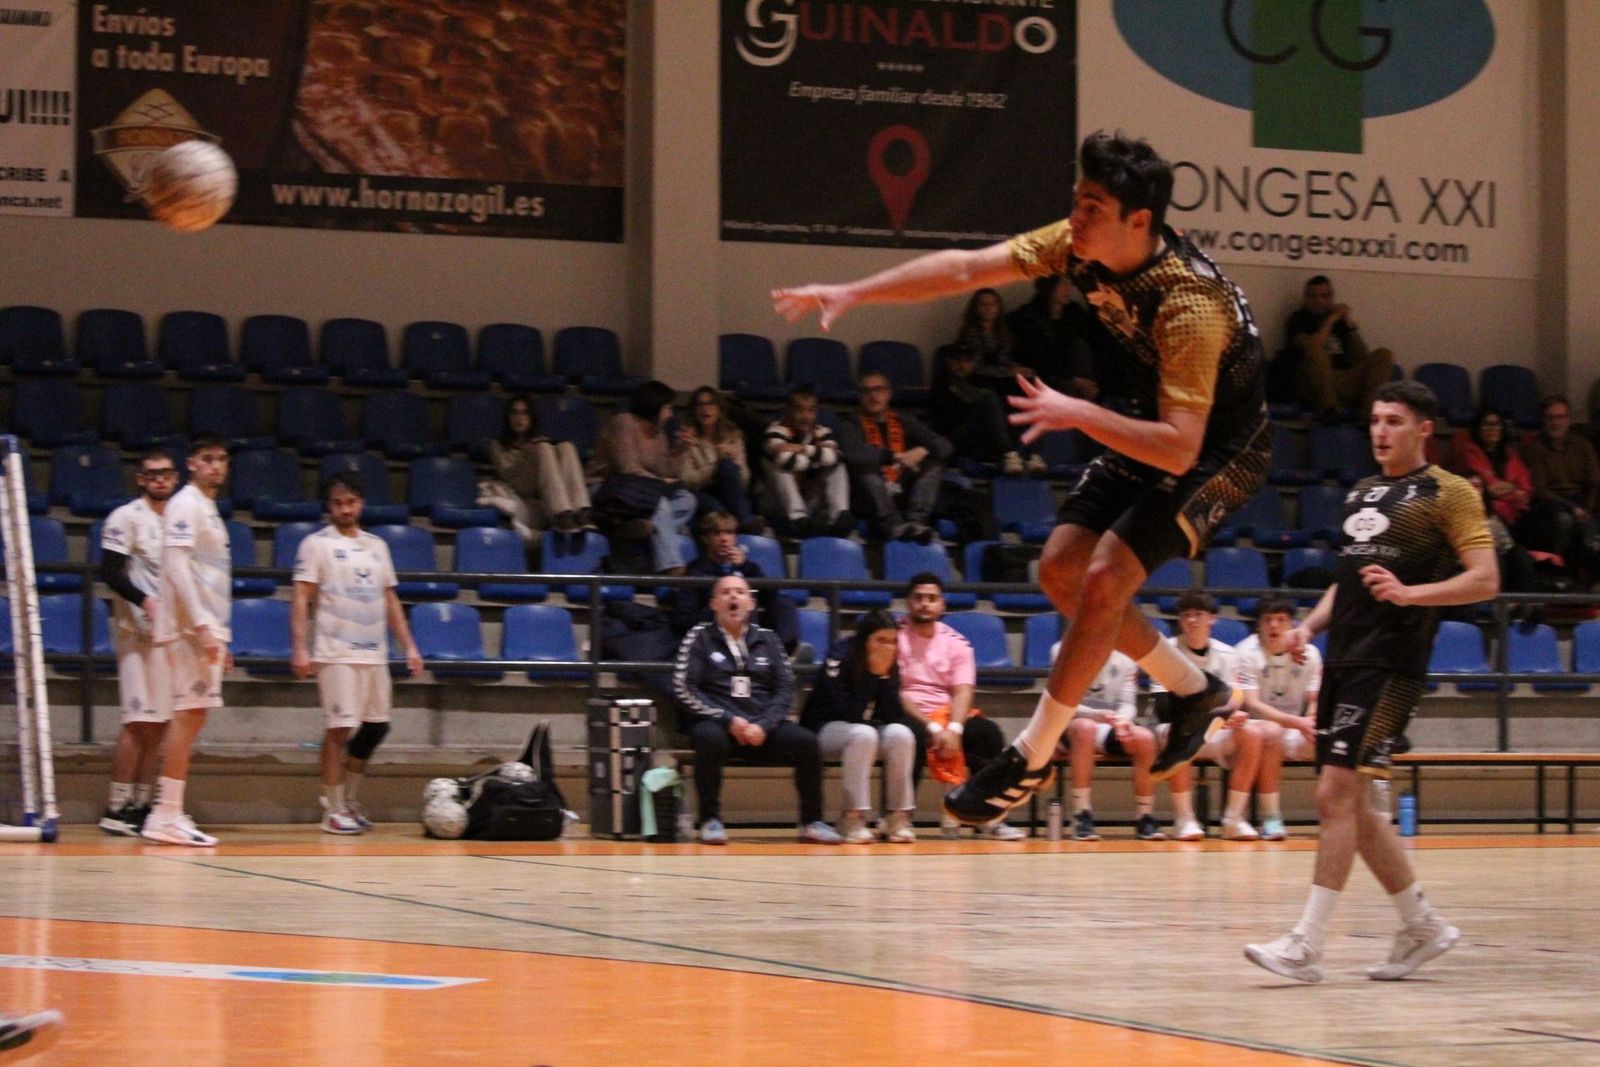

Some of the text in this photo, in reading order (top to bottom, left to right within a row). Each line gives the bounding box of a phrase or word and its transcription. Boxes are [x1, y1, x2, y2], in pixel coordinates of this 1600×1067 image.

[92, 5, 176, 36] Envíos
[91, 43, 270, 85] a toda Europa
[788, 81, 857, 103] Empresa
[855, 84, 919, 105] familiar
[918, 89, 965, 107] desde
[271, 177, 546, 223] www.hornazogil.es
[1166, 160, 1497, 229] ONGESA XXI
